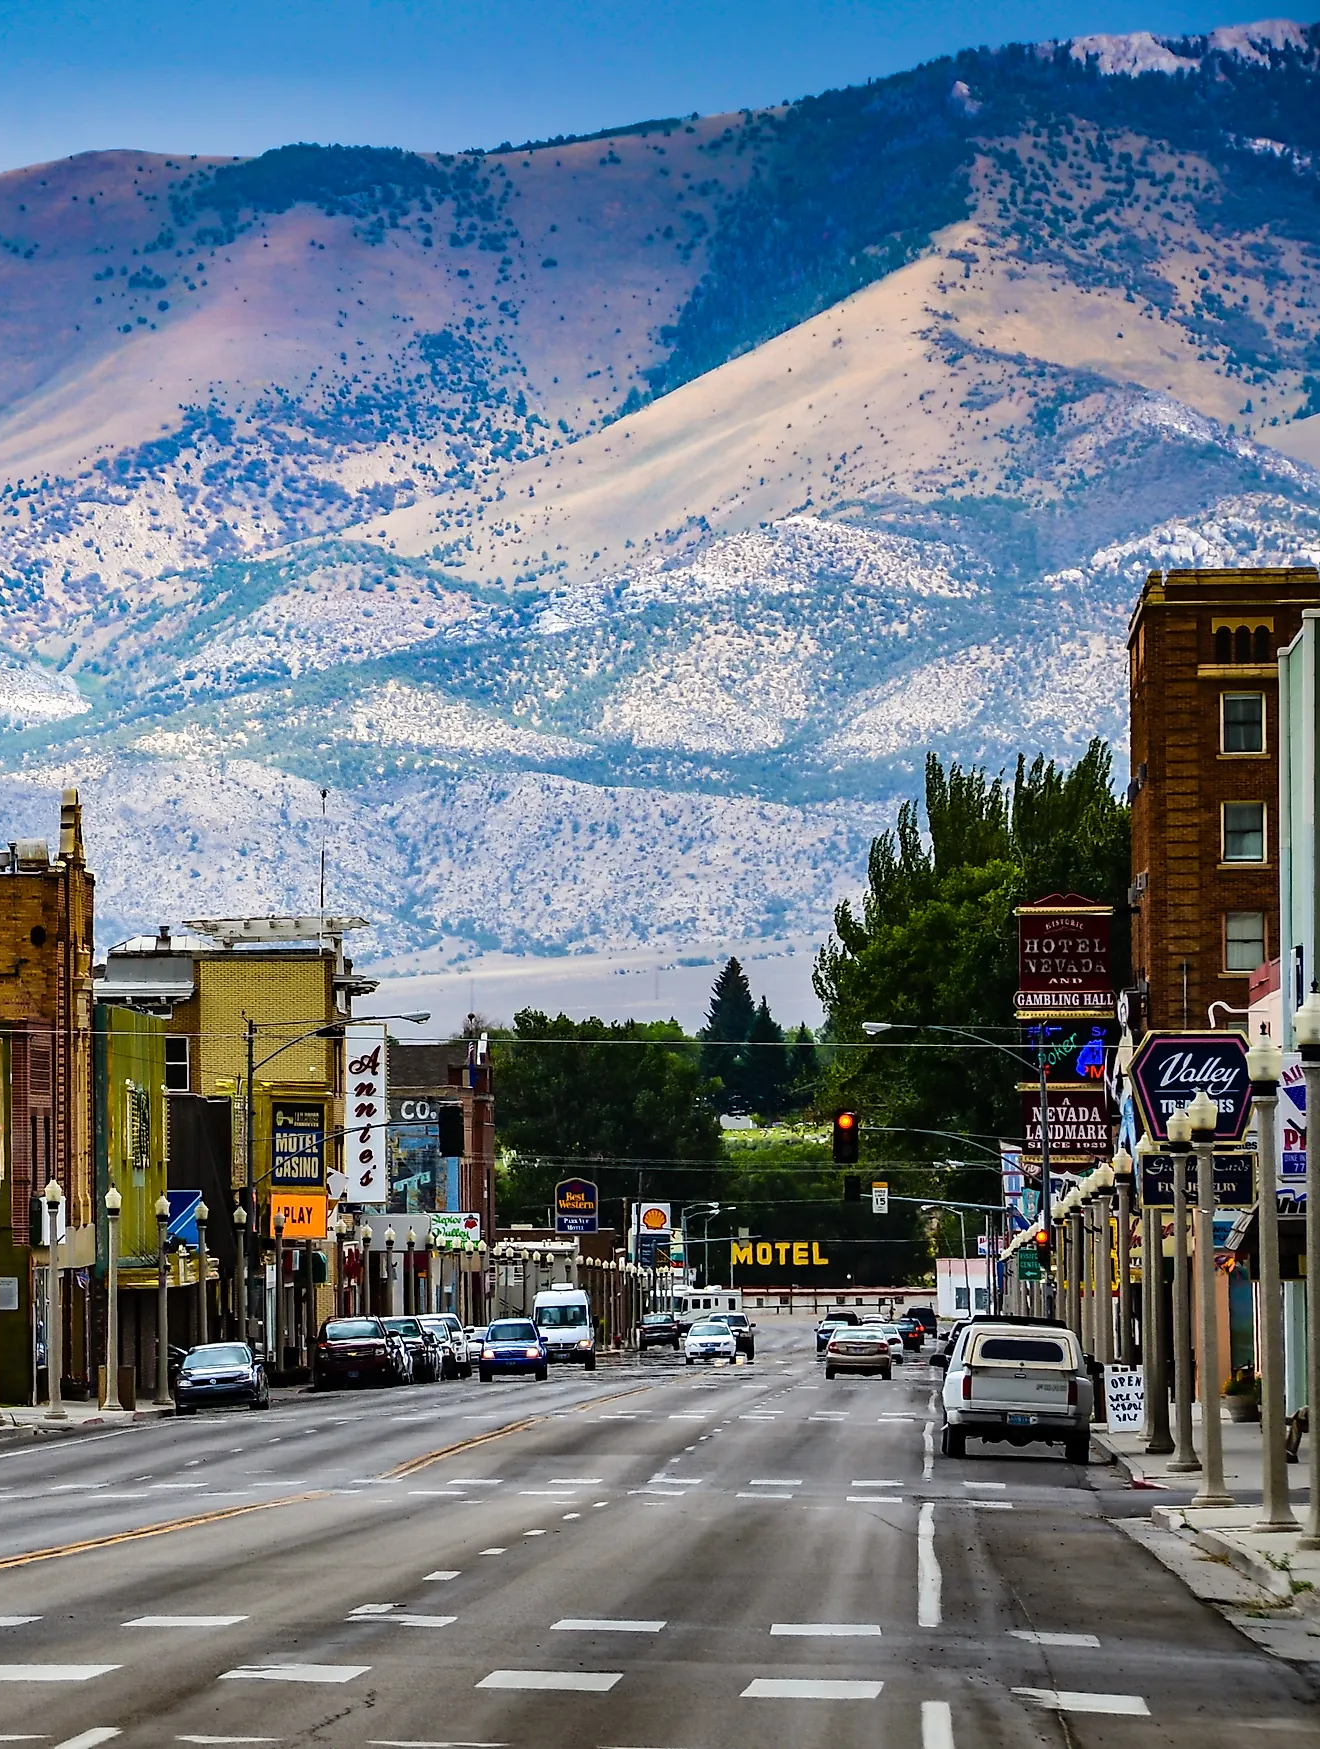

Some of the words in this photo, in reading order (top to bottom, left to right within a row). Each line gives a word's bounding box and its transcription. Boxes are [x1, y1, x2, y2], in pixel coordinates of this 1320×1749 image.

[1045, 919, 1084, 930] HISTORIC
[1024, 939, 1106, 953] HOTEL
[1024, 959, 1106, 973] NEVADA
[1017, 994, 1079, 1006] GAMBLING
[1083, 994, 1114, 1006] HALL
[1159, 1052, 1240, 1095] Valley
[1062, 1097, 1071, 1106] A
[349, 1045, 381, 1186] Annie's
[400, 1100, 437, 1120] CO.
[1032, 1107, 1101, 1122] NEVADA
[275, 1132, 319, 1153] MOTEL
[275, 1156, 319, 1179] CASINO
[566, 1192, 585, 1202] Best
[875, 1198, 886, 1206] 15
[559, 1200, 594, 1210] Western
[284, 1206, 313, 1224] PLAY
[732, 1242, 829, 1265] MOTEL
[1111, 1376, 1142, 1388] OPEN
